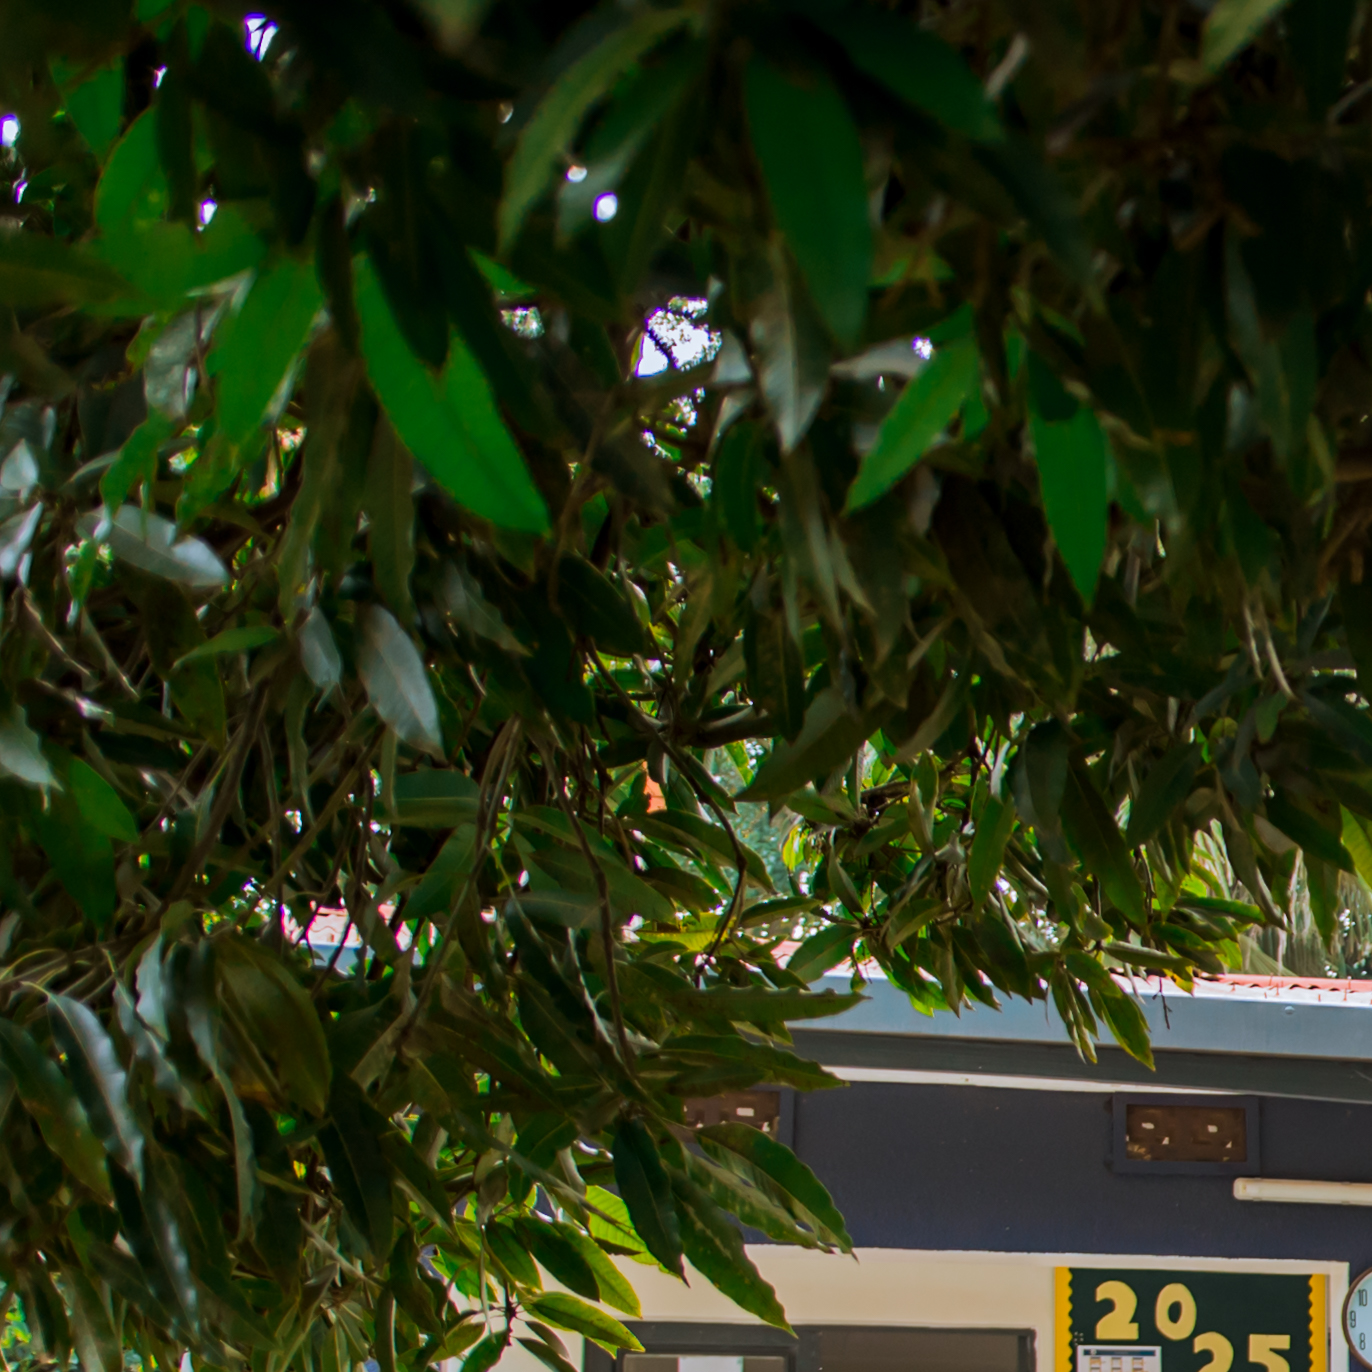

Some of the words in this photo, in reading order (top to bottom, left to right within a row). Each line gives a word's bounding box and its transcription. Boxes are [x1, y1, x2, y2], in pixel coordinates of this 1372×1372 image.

[1358, 1288, 1368, 1307] 10
[1349, 1310, 1357, 1328] 9
[1359, 1332, 1366, 1350] 8
